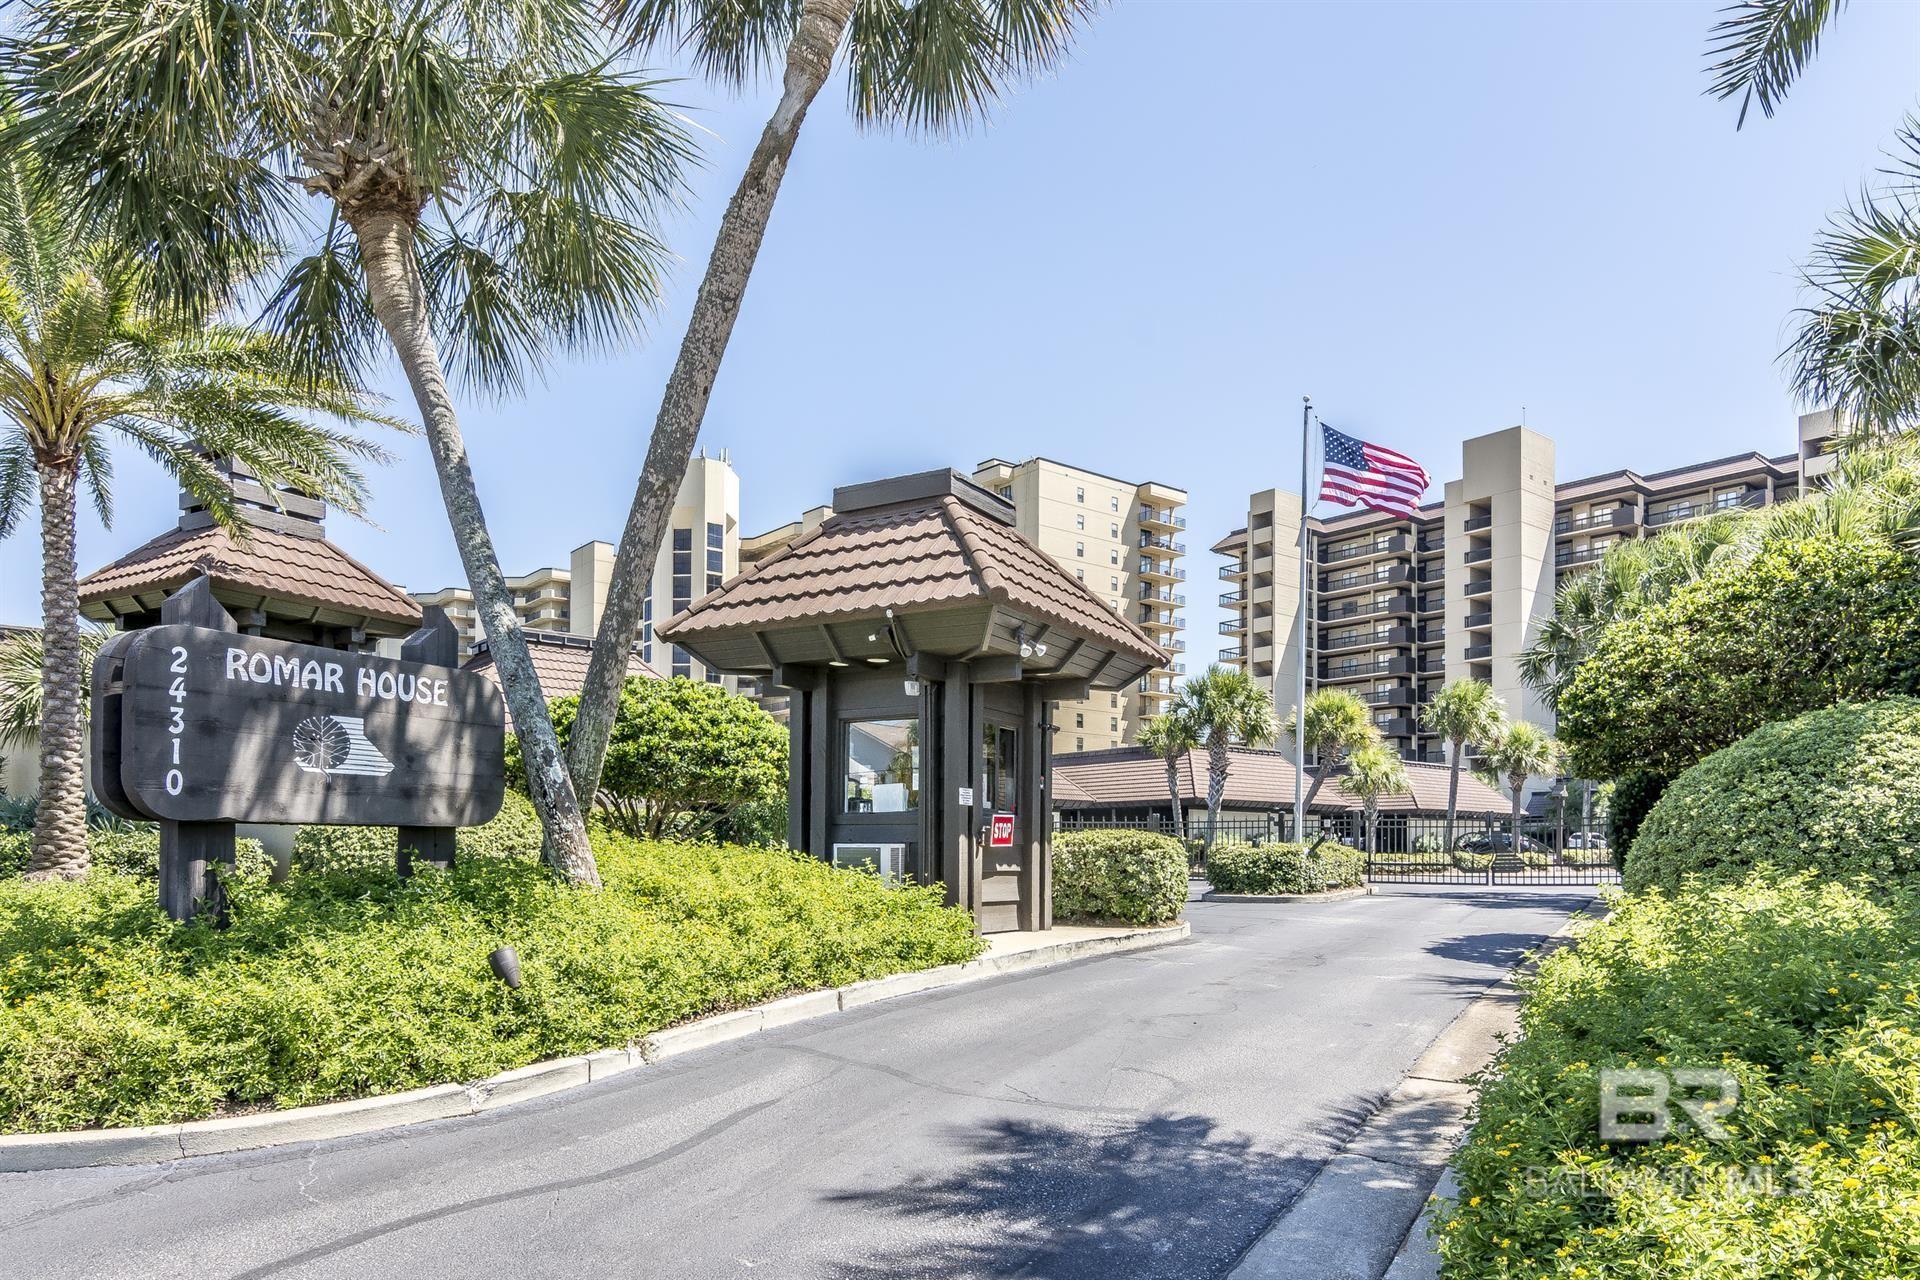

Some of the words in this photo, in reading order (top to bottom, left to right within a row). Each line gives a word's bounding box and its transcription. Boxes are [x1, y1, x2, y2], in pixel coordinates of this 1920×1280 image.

[226, 648, 344, 693] ROMAR
[357, 668, 449, 707] HOUSE
[166, 646, 188, 796] 24310
[994, 822, 1012, 839] STOP
